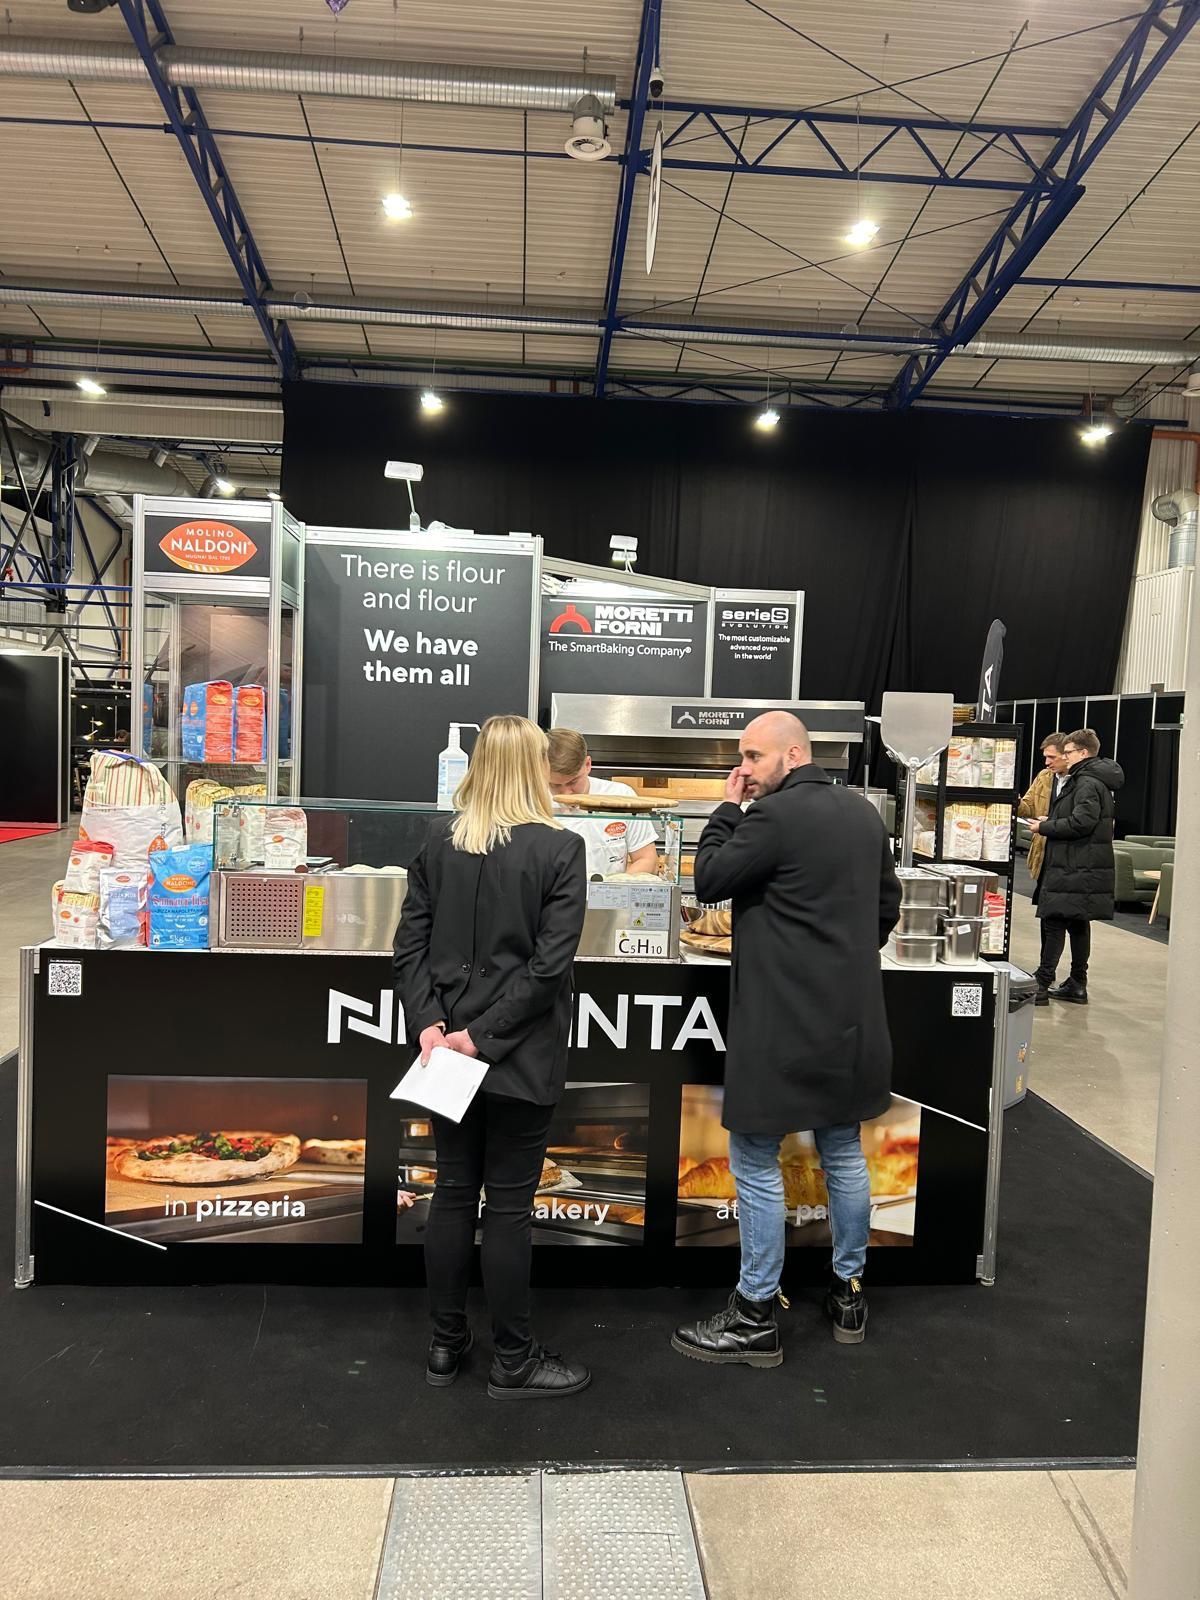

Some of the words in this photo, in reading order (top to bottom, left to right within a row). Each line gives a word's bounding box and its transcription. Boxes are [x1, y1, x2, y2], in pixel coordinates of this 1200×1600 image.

[186, 528, 234, 538] MOLINO
[341, 554, 414, 580] There
[422, 560, 440, 581] is
[446, 560, 506, 585] flour
[363, 588, 411, 610] and
[418, 589, 478, 613] flour
[594, 605, 694, 623] MORETTI
[594, 620, 662, 636] FORNI
[364, 629, 410, 653] We
[416, 631, 479, 657] have
[718, 633, 731, 641] The
[748, 635, 791, 643] customizable
[549, 641, 568, 652] The
[570, 641, 635, 657] SmartBaking
[730, 643, 761, 651] advanced
[741, 652, 753, 660] the
[363, 660, 433, 684] them
[440, 663, 470, 686] all
[698, 711, 745, 719] MORETTI
[327, 987, 727, 1052] NNTA
[164, 1194, 188, 1217] in
[196, 1194, 306, 1222] pizzeria
[531, 1198, 610, 1226] akery
[716, 1203, 739, 1220] at
